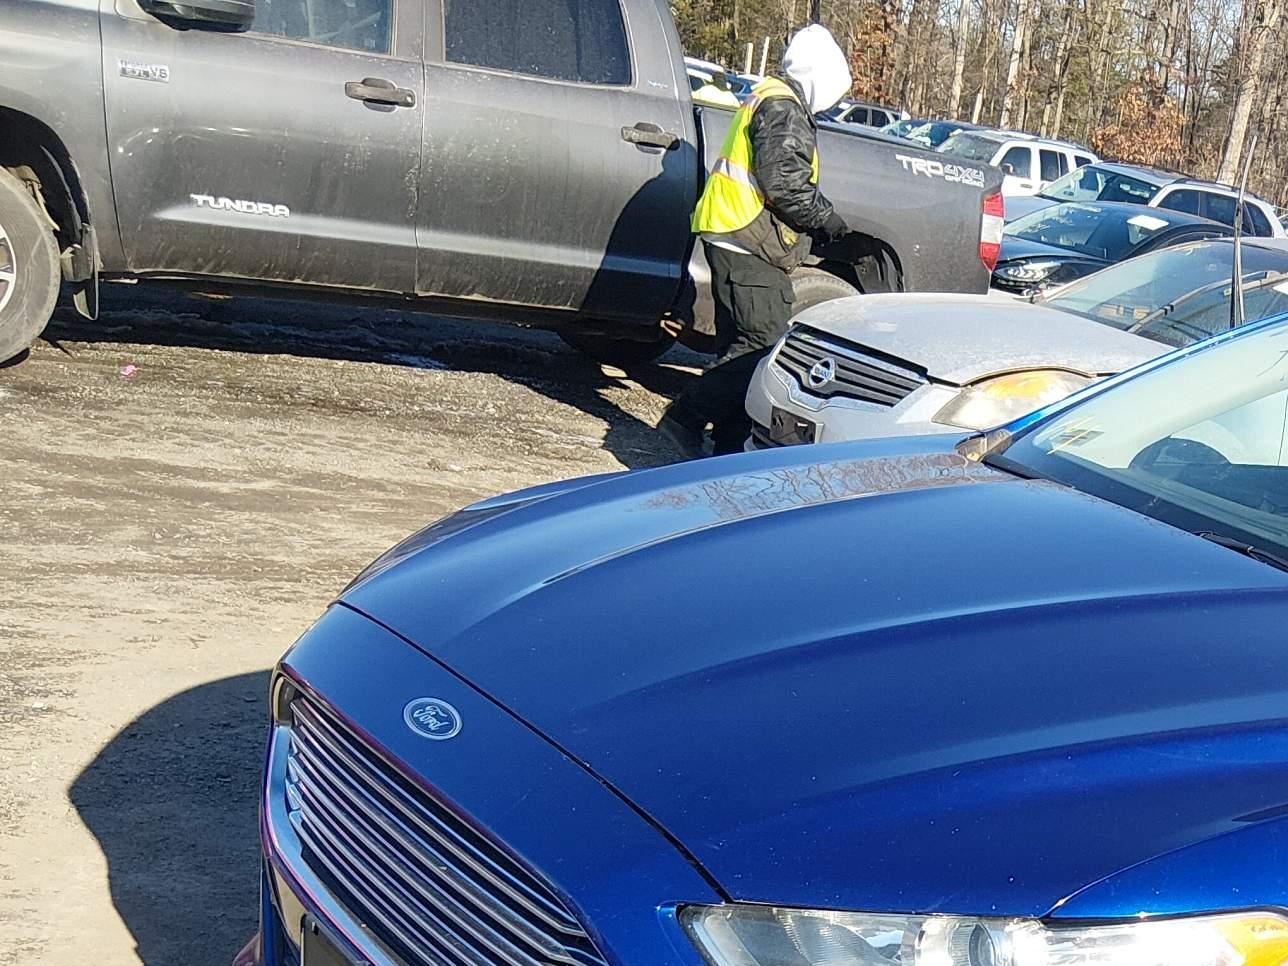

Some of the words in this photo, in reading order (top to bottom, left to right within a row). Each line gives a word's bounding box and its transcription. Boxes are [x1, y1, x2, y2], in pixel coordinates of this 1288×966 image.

[895, 154, 945, 178] TRD
[190, 193, 289, 218] TUNDRA
[413, 705, 449, 731] Ford
